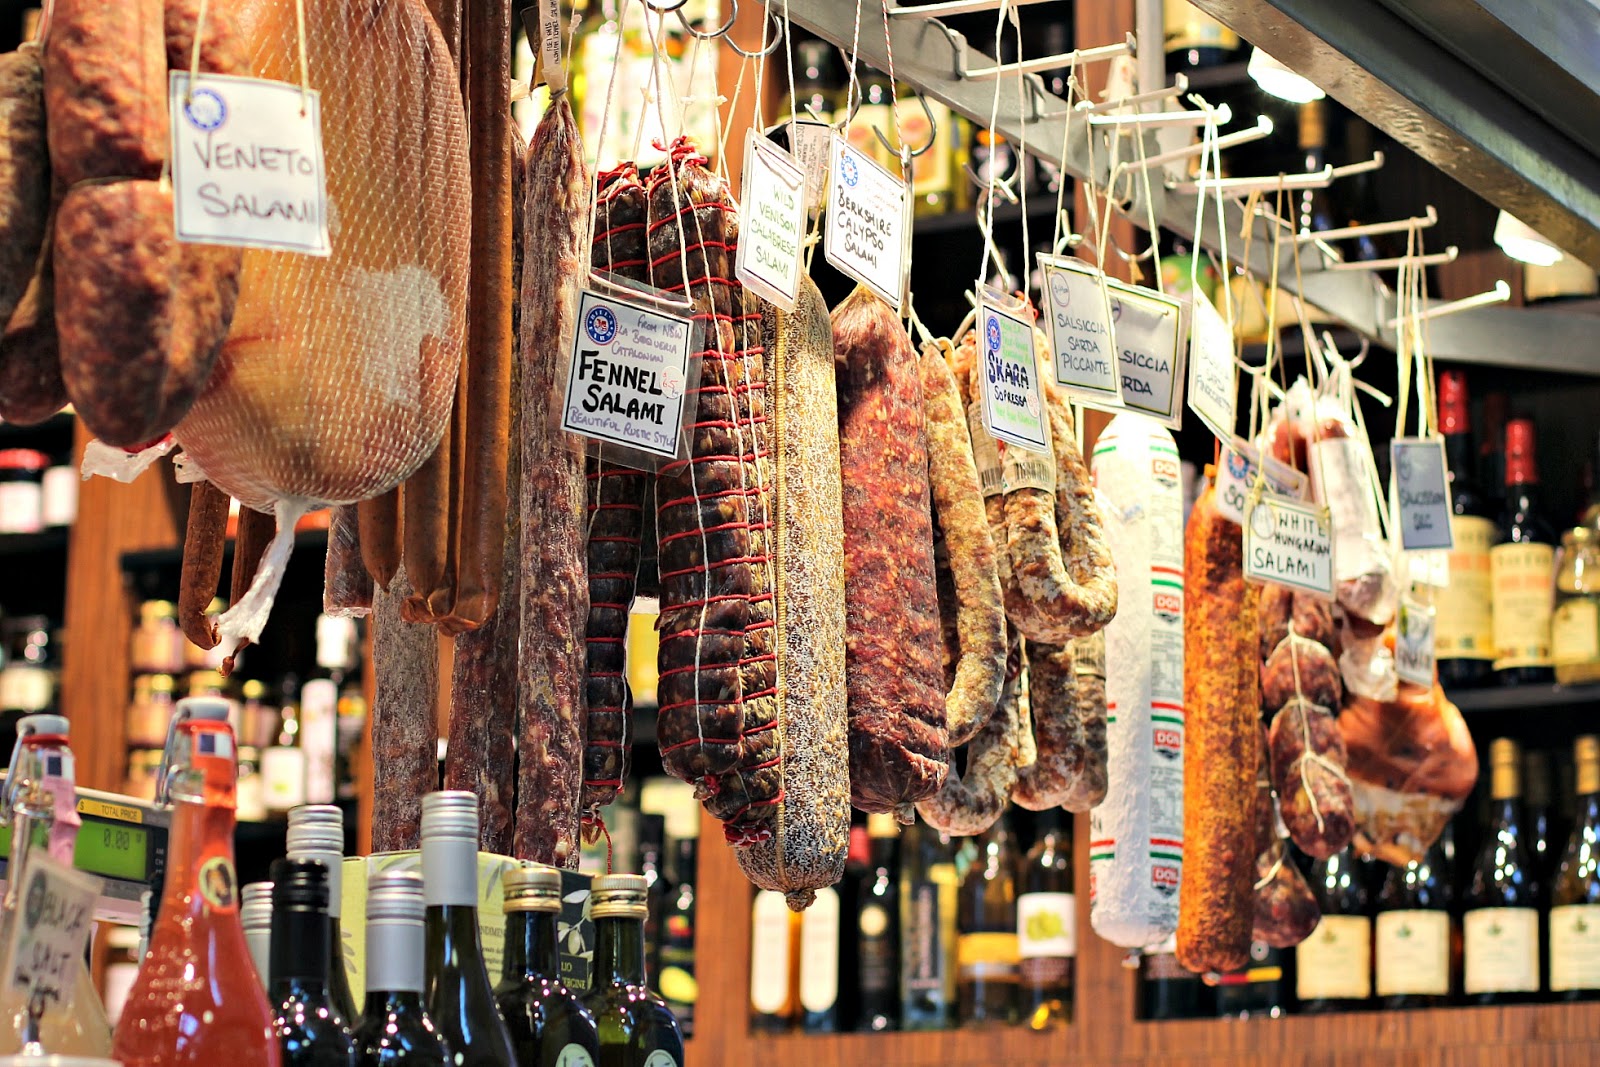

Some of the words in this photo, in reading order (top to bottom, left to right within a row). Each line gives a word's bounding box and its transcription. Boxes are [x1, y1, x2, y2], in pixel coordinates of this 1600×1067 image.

[193, 131, 313, 175] VENETO
[197, 182, 316, 225] SALAMI
[773, 184, 795, 211] WILD
[838, 184, 892, 237] BERKSHIRE
[759, 201, 797, 236] VENISON
[837, 211, 884, 251] CALYPSO
[751, 219, 797, 258] CALABRESE
[844, 233, 878, 269] SALAMI
[756, 245, 789, 280] SALAMI
[662, 325, 683, 340] NSW
[1057, 313, 1108, 336] SALSICCIA
[1067, 336, 1101, 354] SARDA
[578, 349, 662, 396] FENNEL
[987, 349, 1030, 390] SKARA
[1061, 352, 1111, 376] PICCANTE
[1122, 376, 1153, 396] RDA
[582, 384, 665, 425] SALAMI
[569, 406, 620, 432] BEAUTIFUL
[623, 422, 651, 441] RUSTIC
[1279, 512, 1326, 538] WHITE
[1254, 547, 1315, 580] SALAMI
[80, 801, 85, 811] $
[101, 805, 119, 817] TOTAL
[120, 809, 138, 821] PRICE
